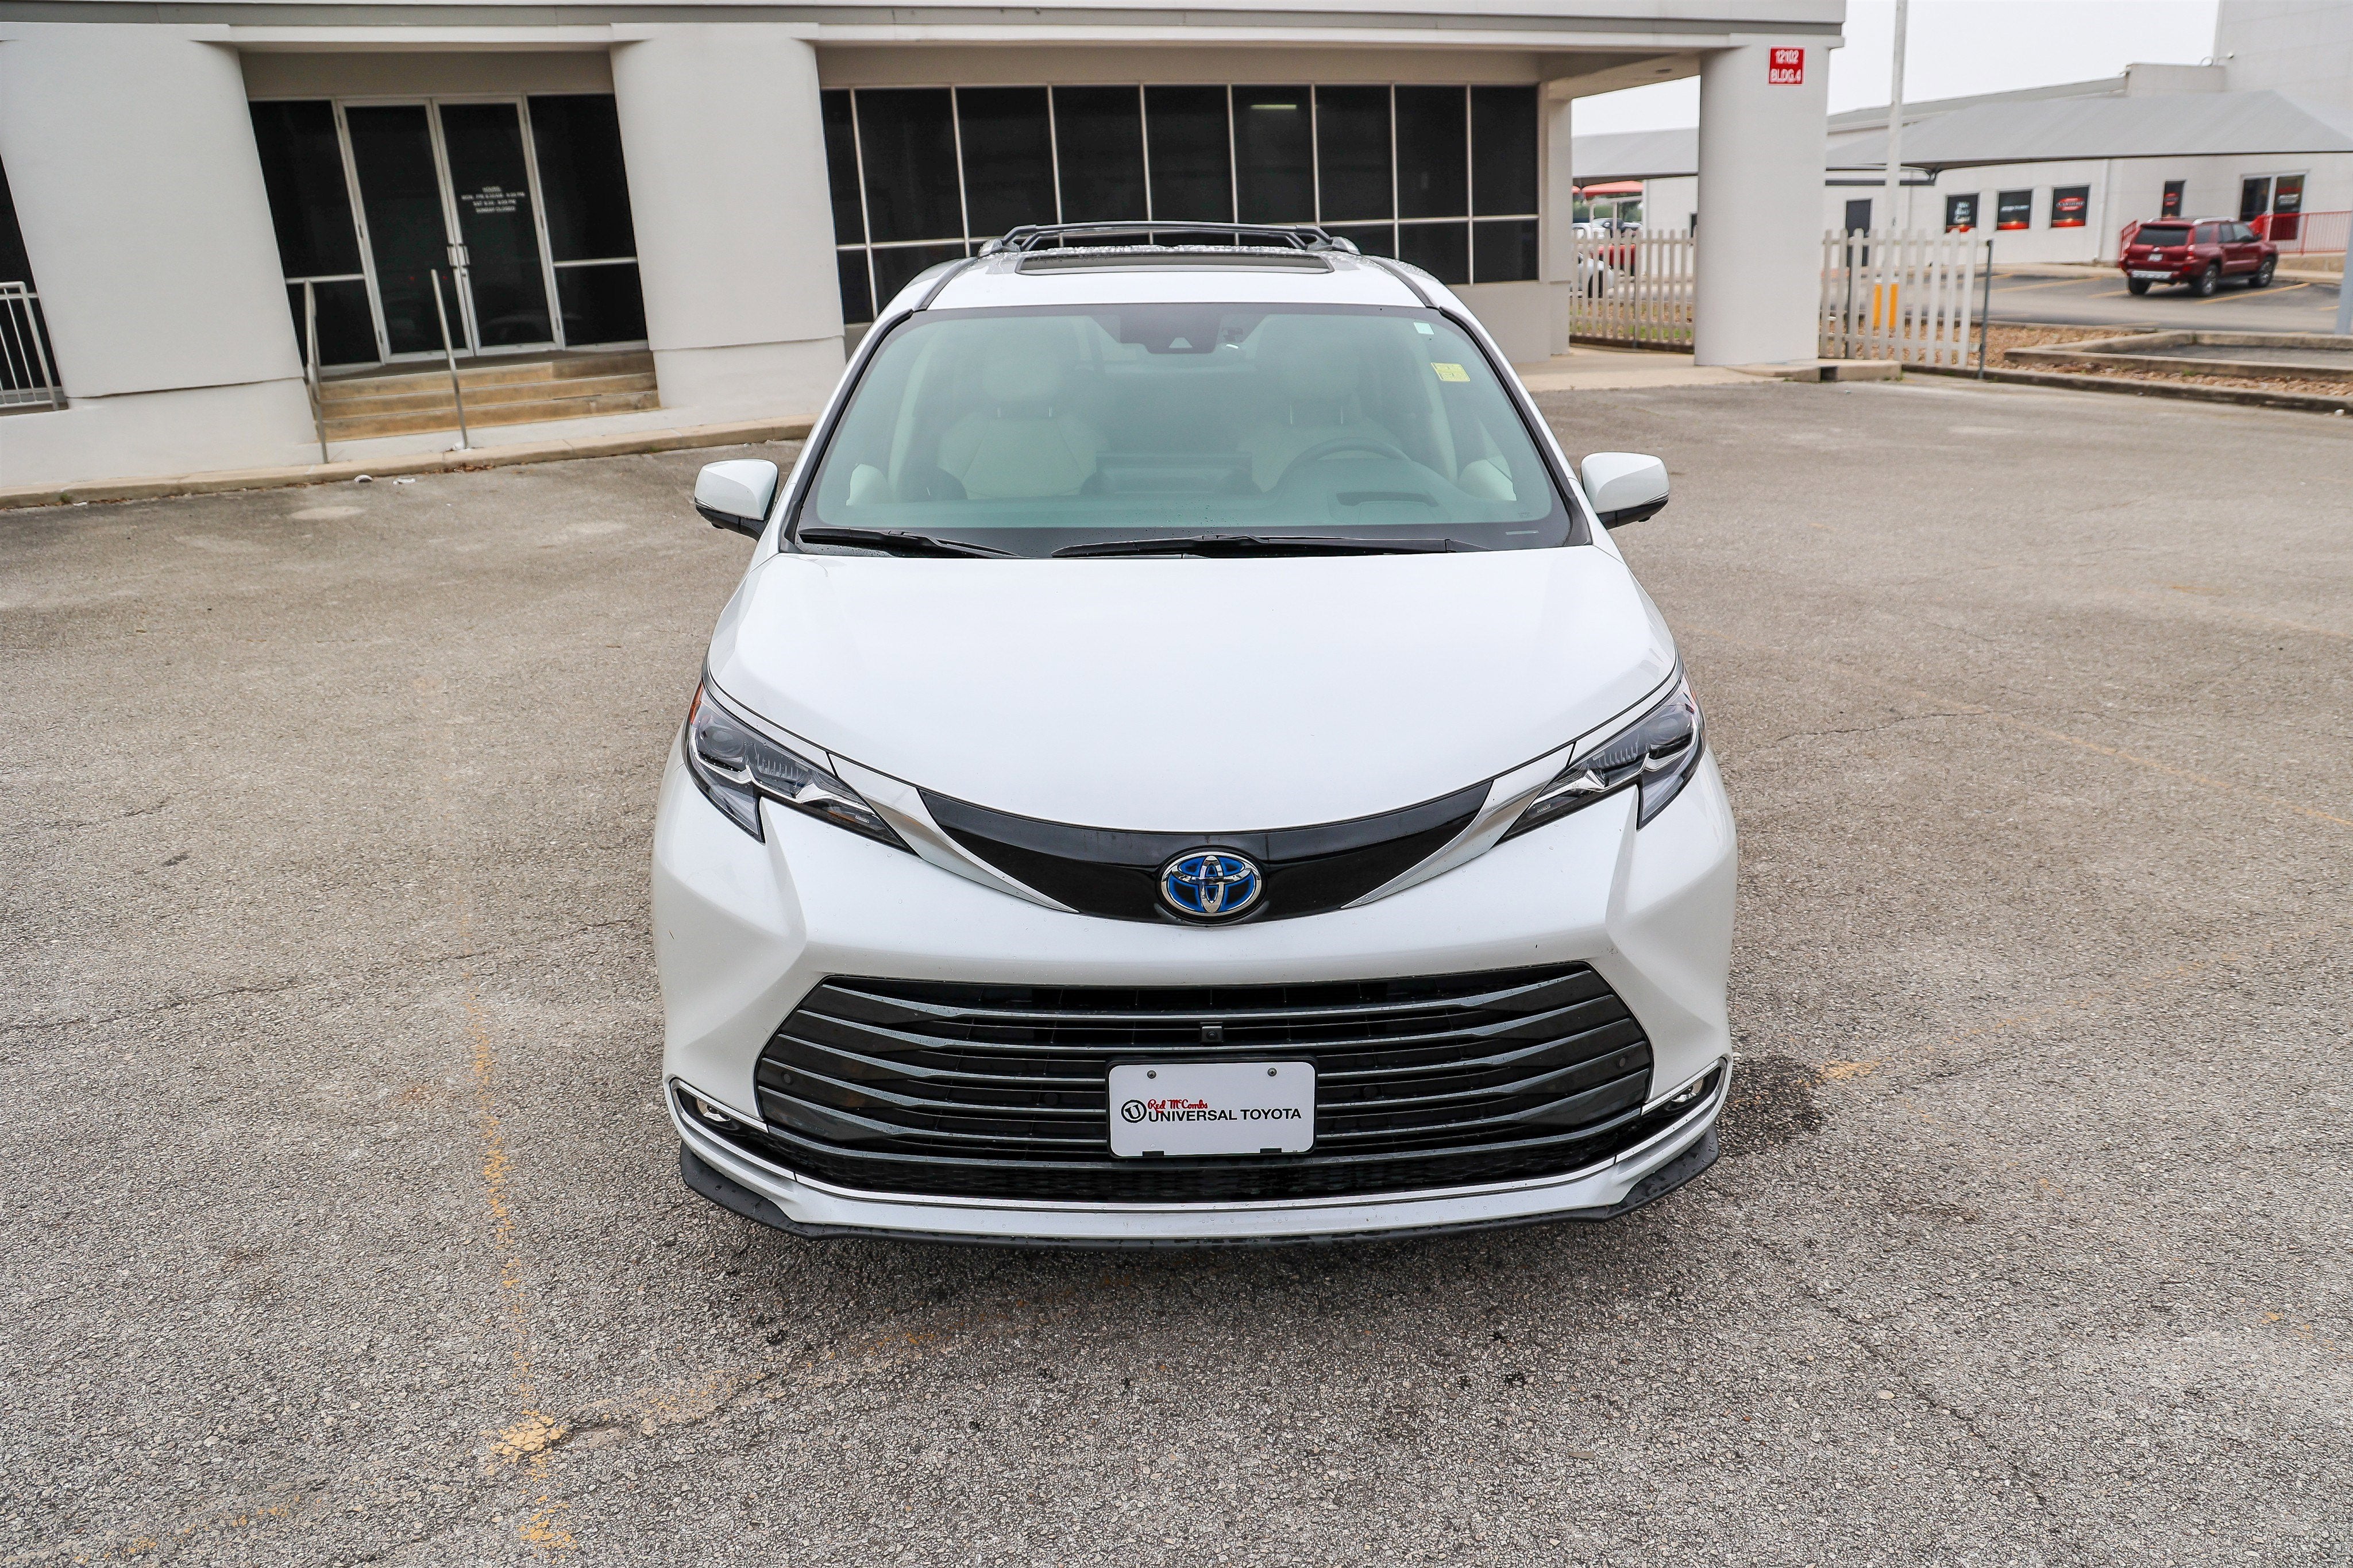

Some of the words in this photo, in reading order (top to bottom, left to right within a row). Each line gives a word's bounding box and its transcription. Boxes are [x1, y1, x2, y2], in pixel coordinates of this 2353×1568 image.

[1775, 49, 1799, 64] 12102
[1148, 1099, 1166, 1113] Red
[1167, 1099, 1208, 1109] McCombs
[1149, 1109, 1237, 1122] UNIVERSAL
[1240, 1108, 1302, 1120] TOYOTA
